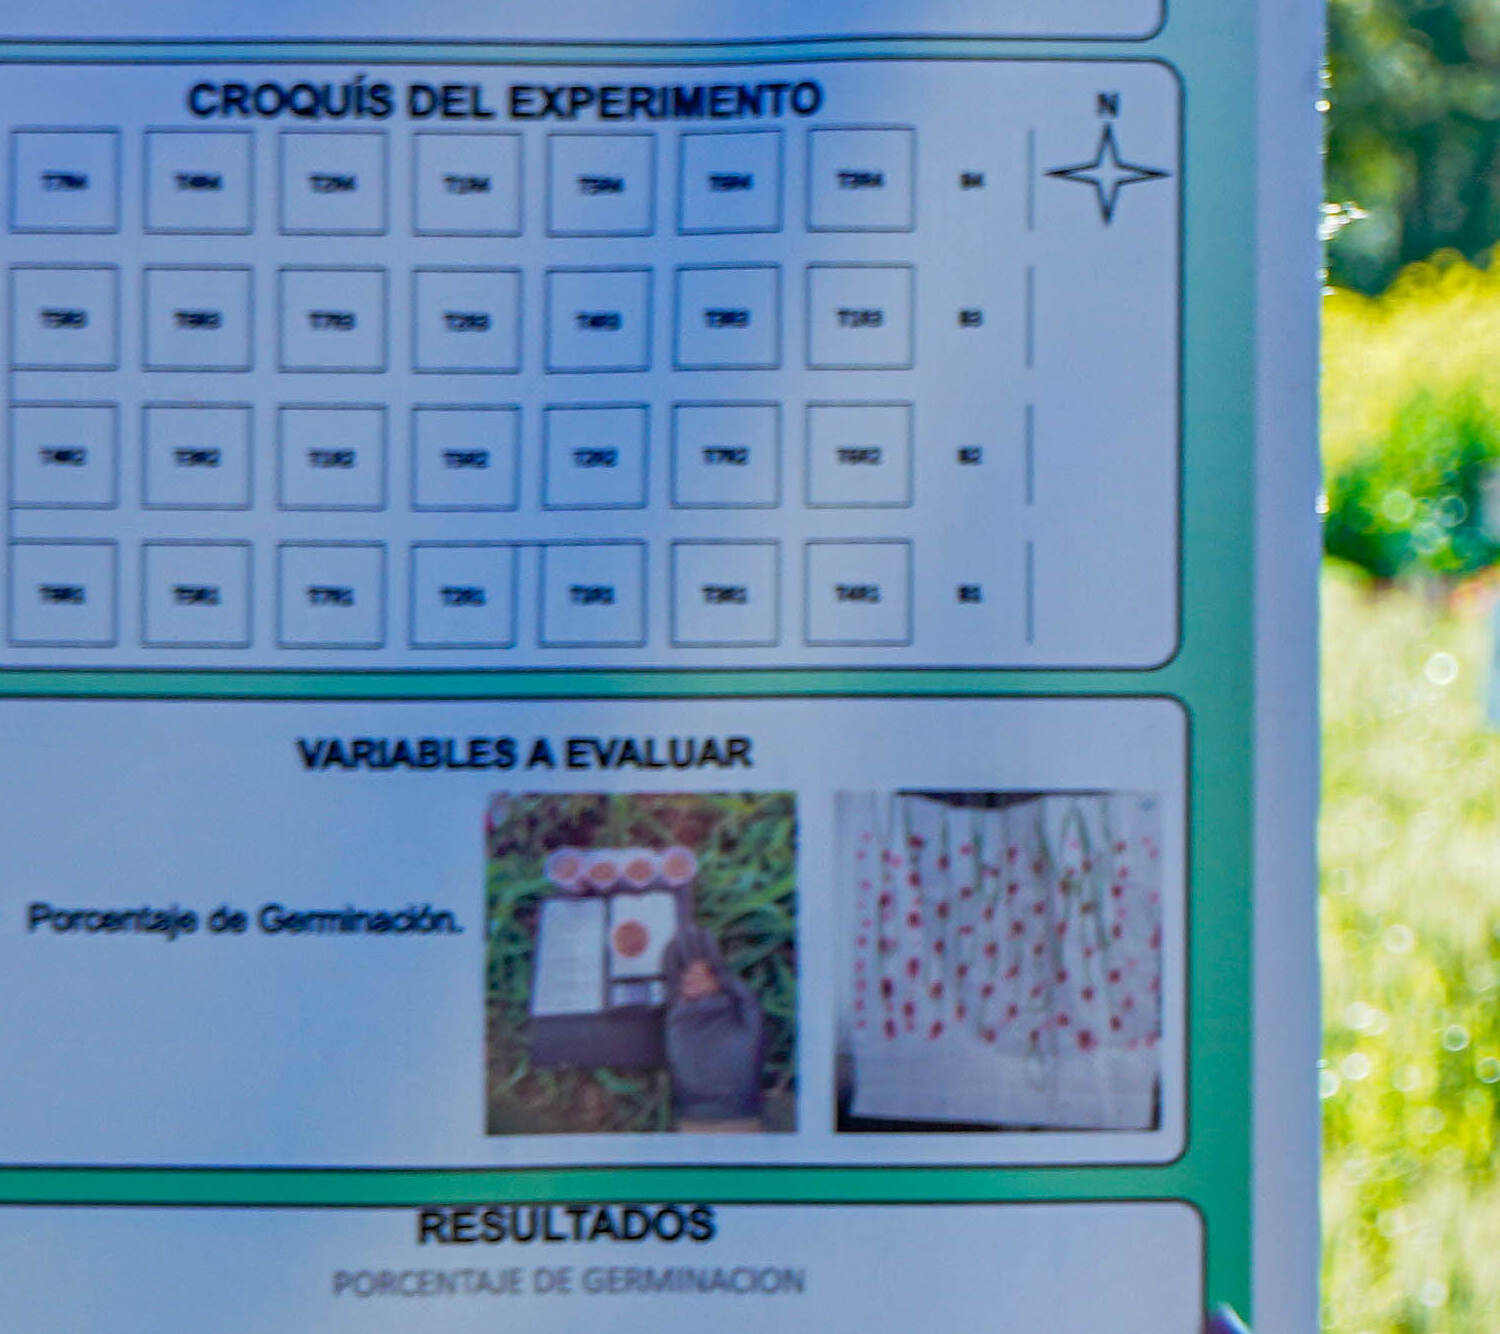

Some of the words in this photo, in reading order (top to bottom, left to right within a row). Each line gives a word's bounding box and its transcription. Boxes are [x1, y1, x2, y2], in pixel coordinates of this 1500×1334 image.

[407, 82, 496, 121] DEL
[508, 78, 824, 121] EXPERIMENTO
[1098, 92, 1119, 118] N
[296, 736, 518, 771] VARIABLES
[526, 737, 556, 770] A
[565, 736, 753, 771] EVALUAR
[28, 902, 199, 941] Porcentaje
[207, 905, 248, 935] de
[258, 903, 463, 935] Germinación.
[418, 1206, 716, 1244] RESULTADOS
[333, 1267, 521, 1298] PORCENTAJE
[534, 1266, 571, 1295] DE
[582, 1266, 804, 1295] GERMINACION
